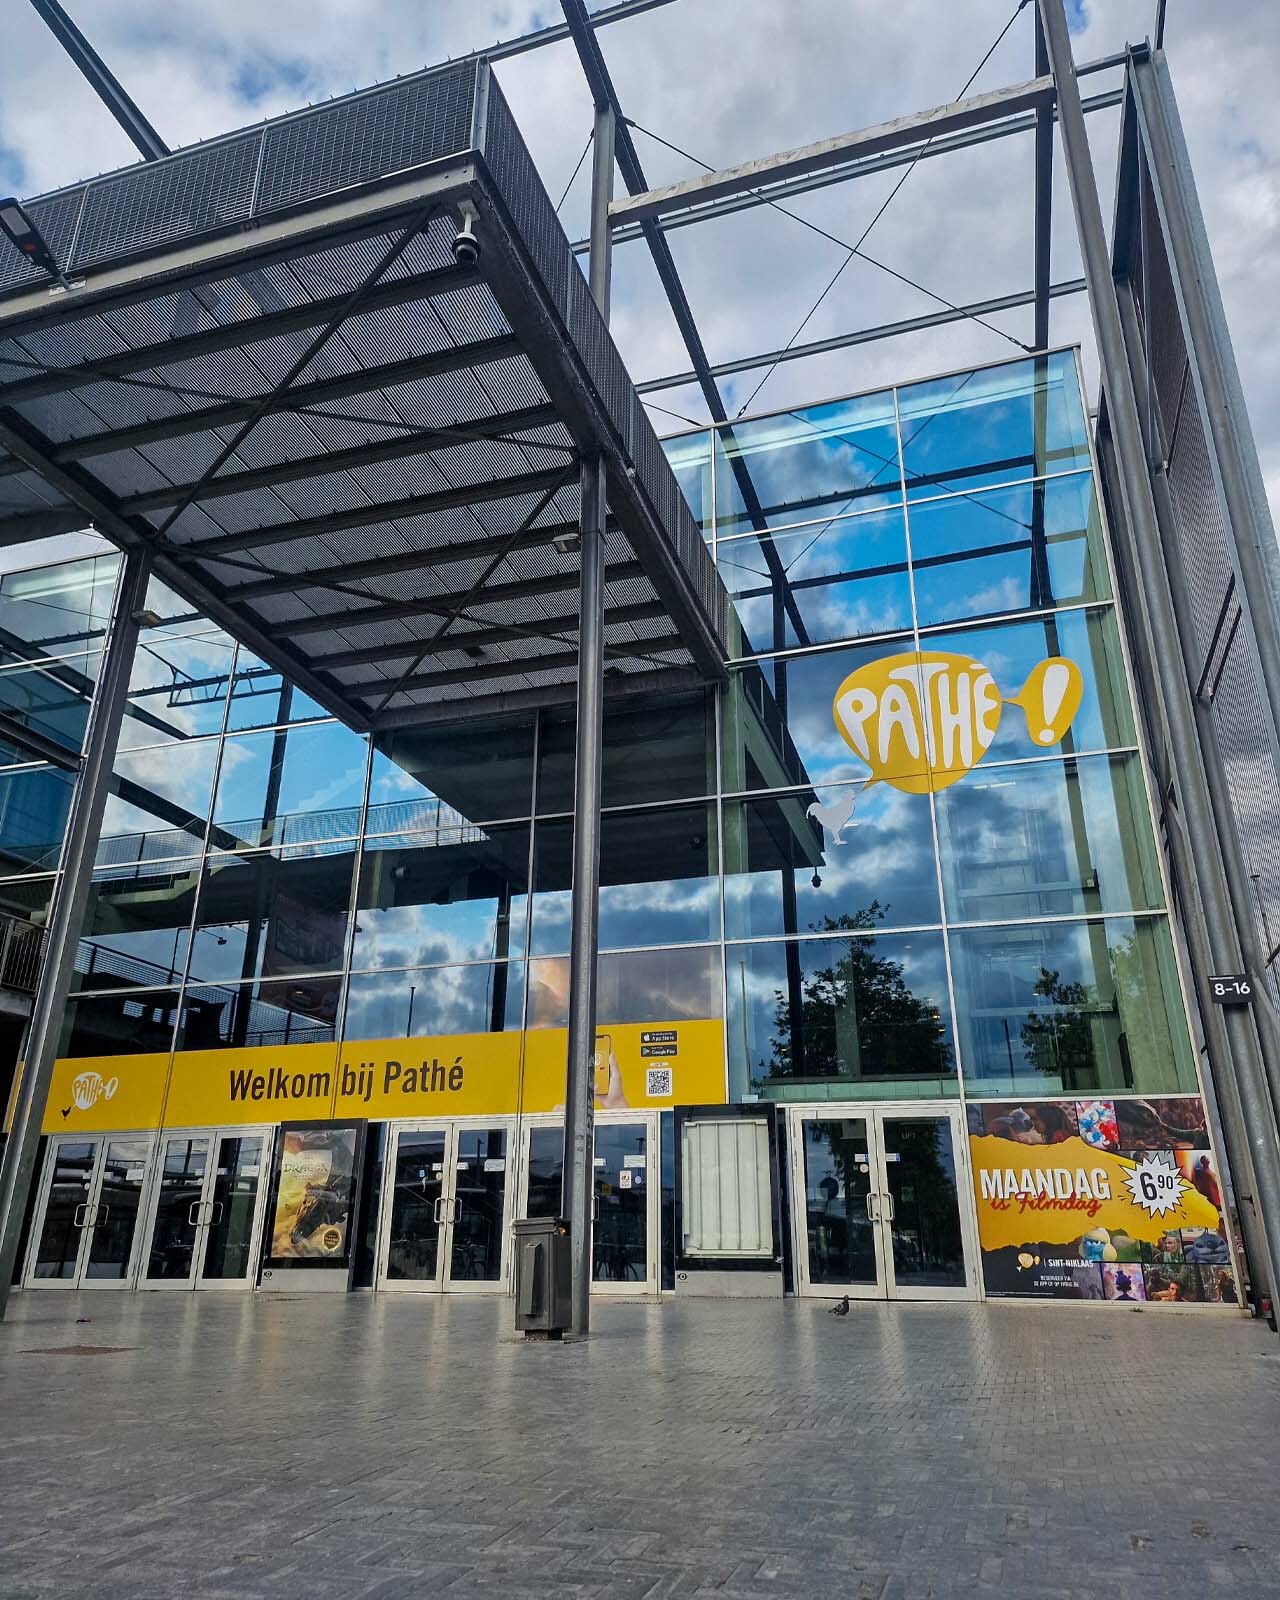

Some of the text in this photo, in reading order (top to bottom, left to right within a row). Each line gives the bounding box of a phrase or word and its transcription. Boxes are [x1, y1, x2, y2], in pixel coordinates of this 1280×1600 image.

[1214, 981, 1251, 996] 8-16
[229, 1056, 465, 1103] Welkom bij Pathé
[979, 1167, 1112, 1201] MAANDAG
[991, 1191, 1103, 1218] is Filmdag
[1048, 1258, 1094, 1268] SINT-NIKLAAS
